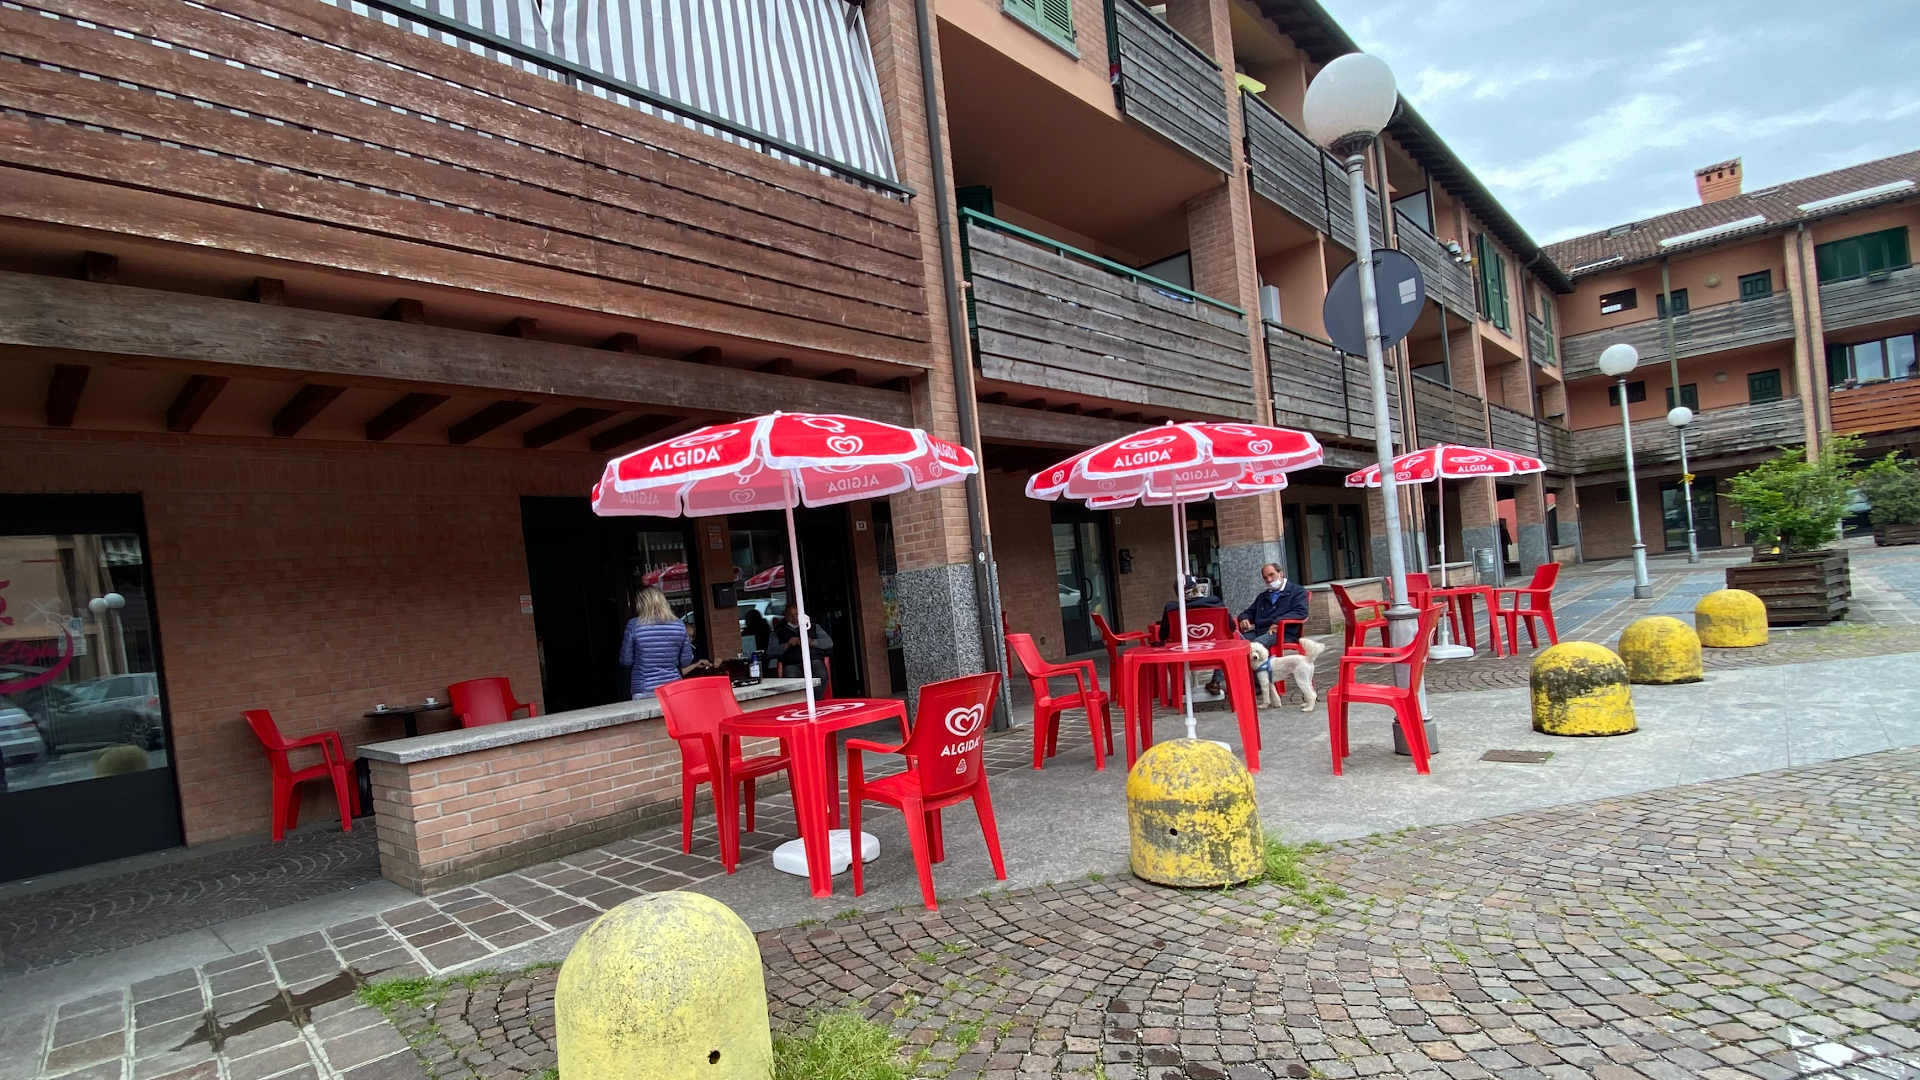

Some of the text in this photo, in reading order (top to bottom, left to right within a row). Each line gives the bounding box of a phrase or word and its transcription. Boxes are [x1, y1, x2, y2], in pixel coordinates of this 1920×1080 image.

[649, 446, 720, 472] ALGIDA
[936, 441, 959, 462] ALGIDA
[1113, 449, 1172, 468] ALGIDA
[1457, 464, 1495, 473] ALGIDA
[940, 739, 980, 757] ALGIDA
